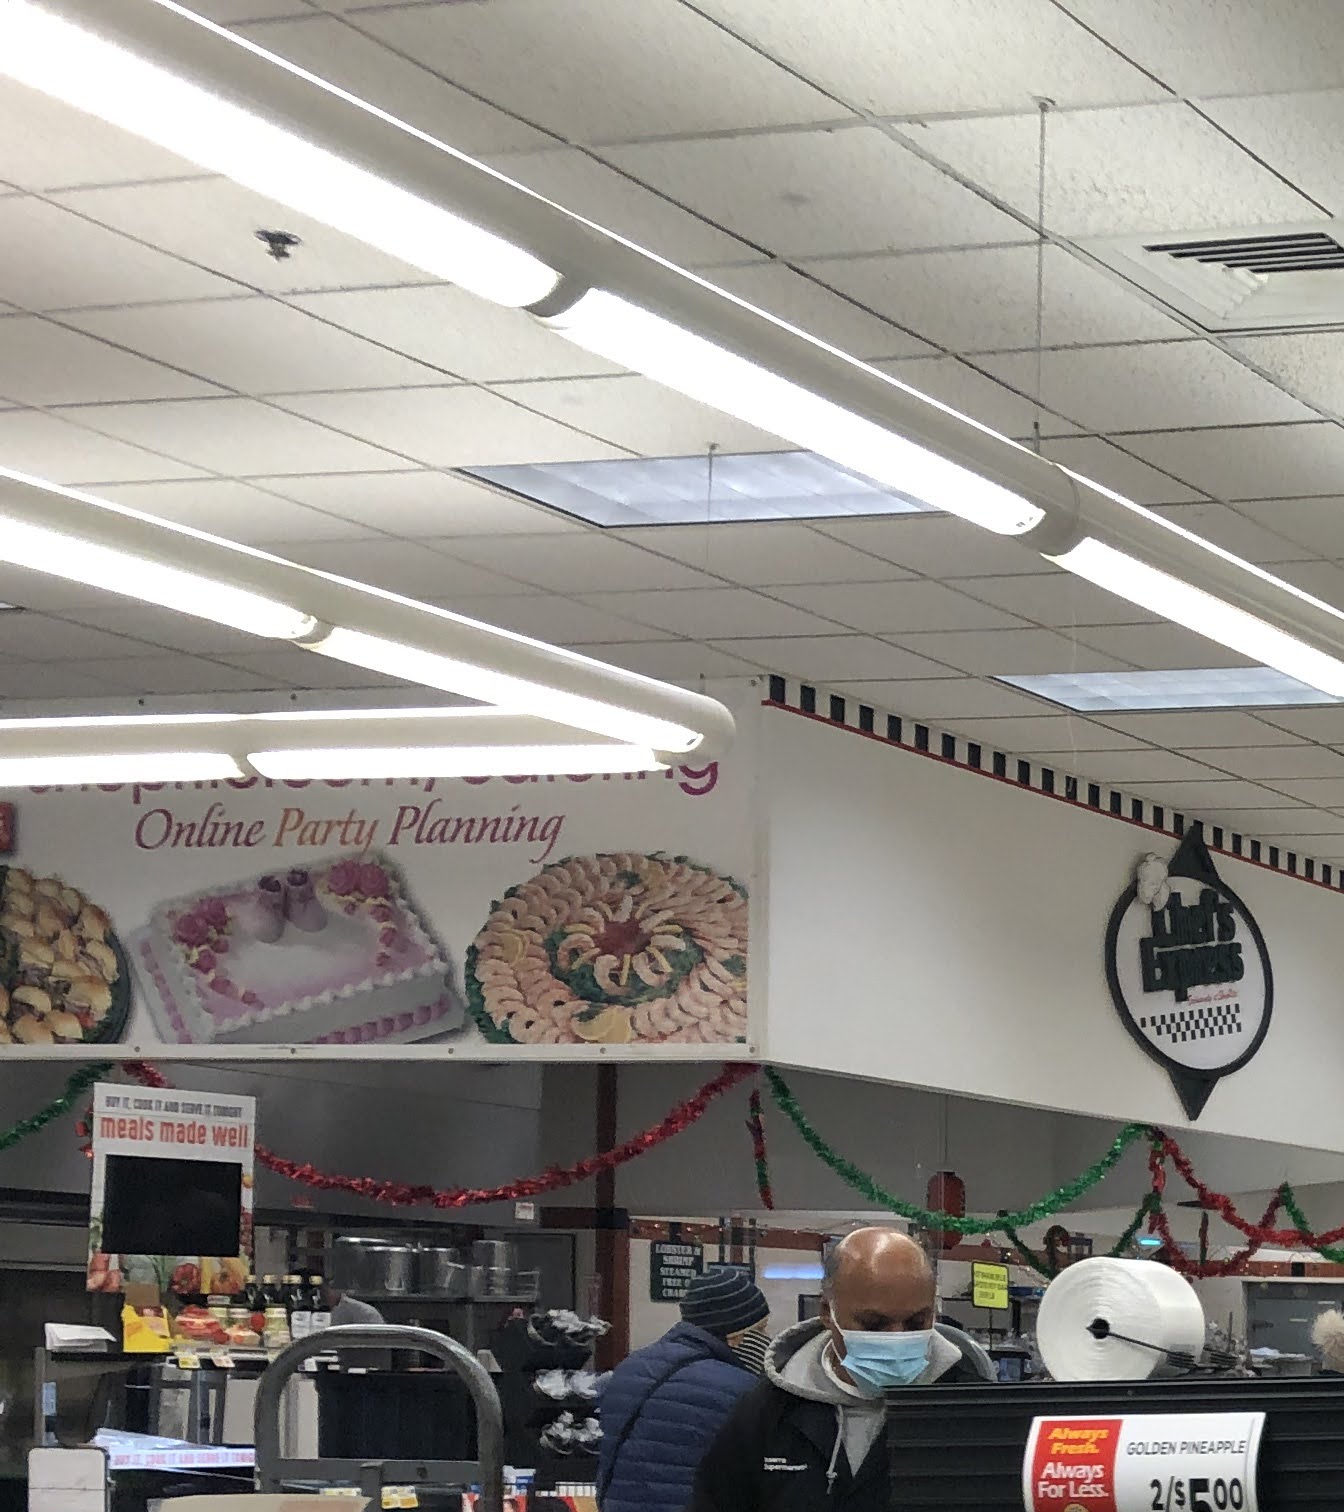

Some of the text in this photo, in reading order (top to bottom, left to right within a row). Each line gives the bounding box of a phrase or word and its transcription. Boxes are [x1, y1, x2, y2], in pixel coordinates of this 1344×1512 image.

[134, 798, 566, 864] Online Party Planning
[101, 1116, 248, 1148] meals made well
[1047, 1427, 1109, 1442] Always
[1127, 1440, 1247, 1456] GOLDEN PINEAPPLE
[1040, 1462, 1105, 1484] Always
[1038, 1480, 1109, 1499] For Less.
